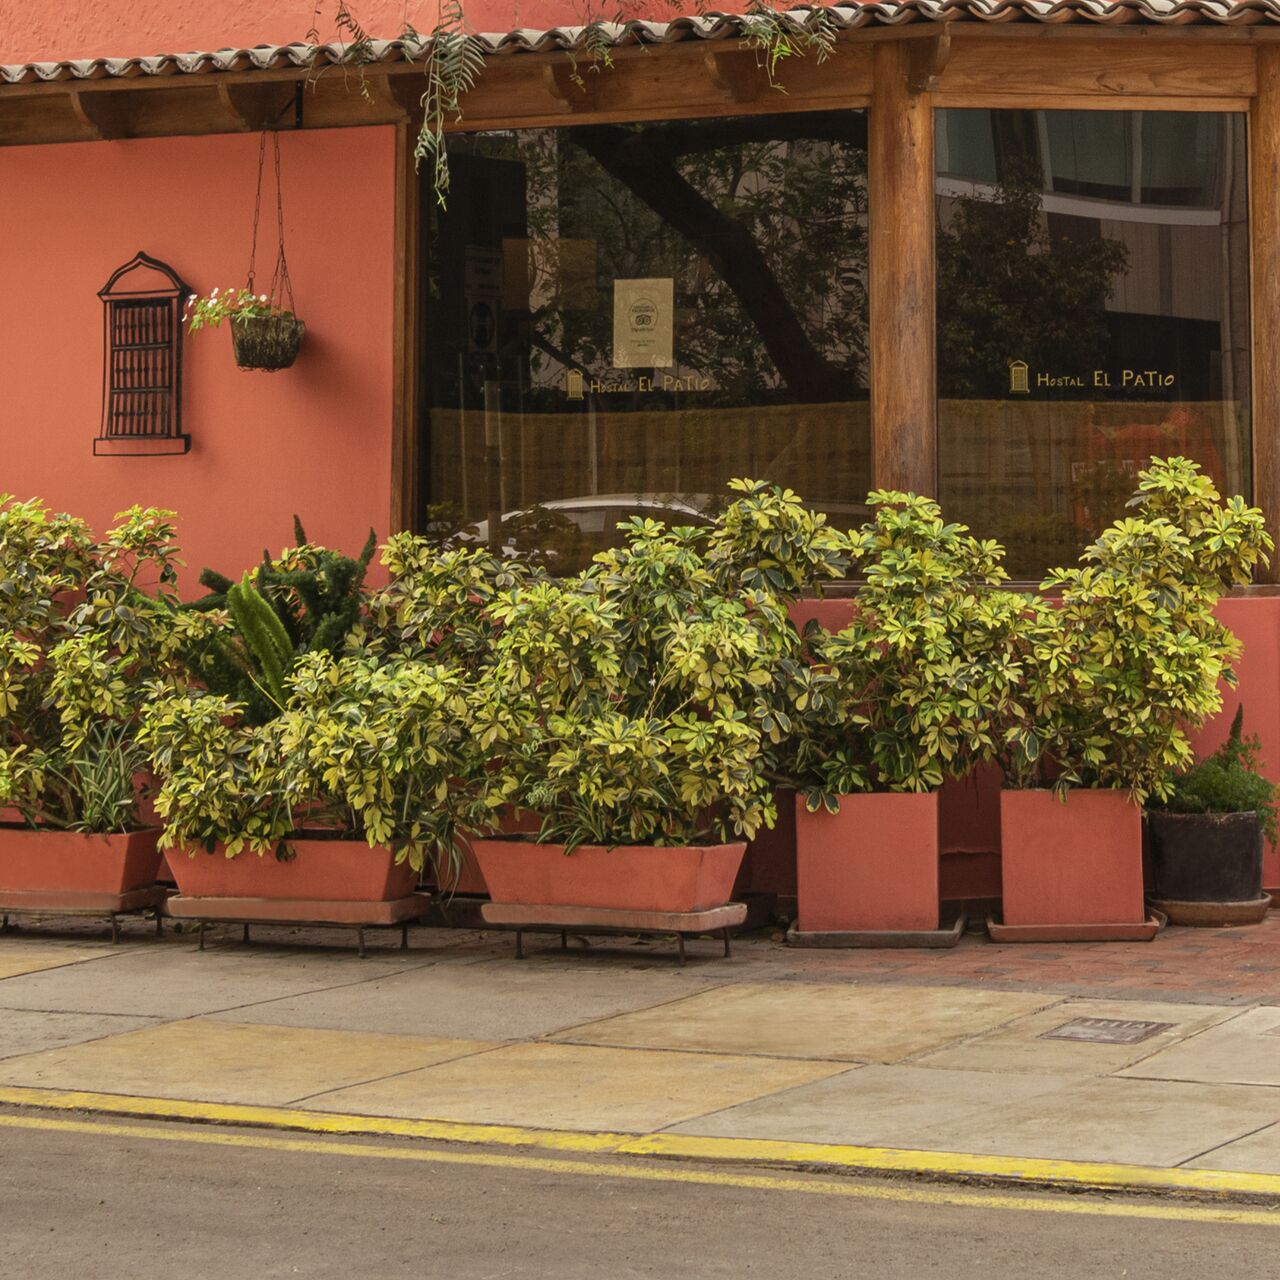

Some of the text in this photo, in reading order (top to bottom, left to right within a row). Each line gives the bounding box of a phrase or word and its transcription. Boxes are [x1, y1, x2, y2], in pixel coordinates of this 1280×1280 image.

[638, 376, 655, 392] EL
[663, 375, 710, 392] PATIO
[1037, 369, 1175, 387] HOSTAL EL PATIO
